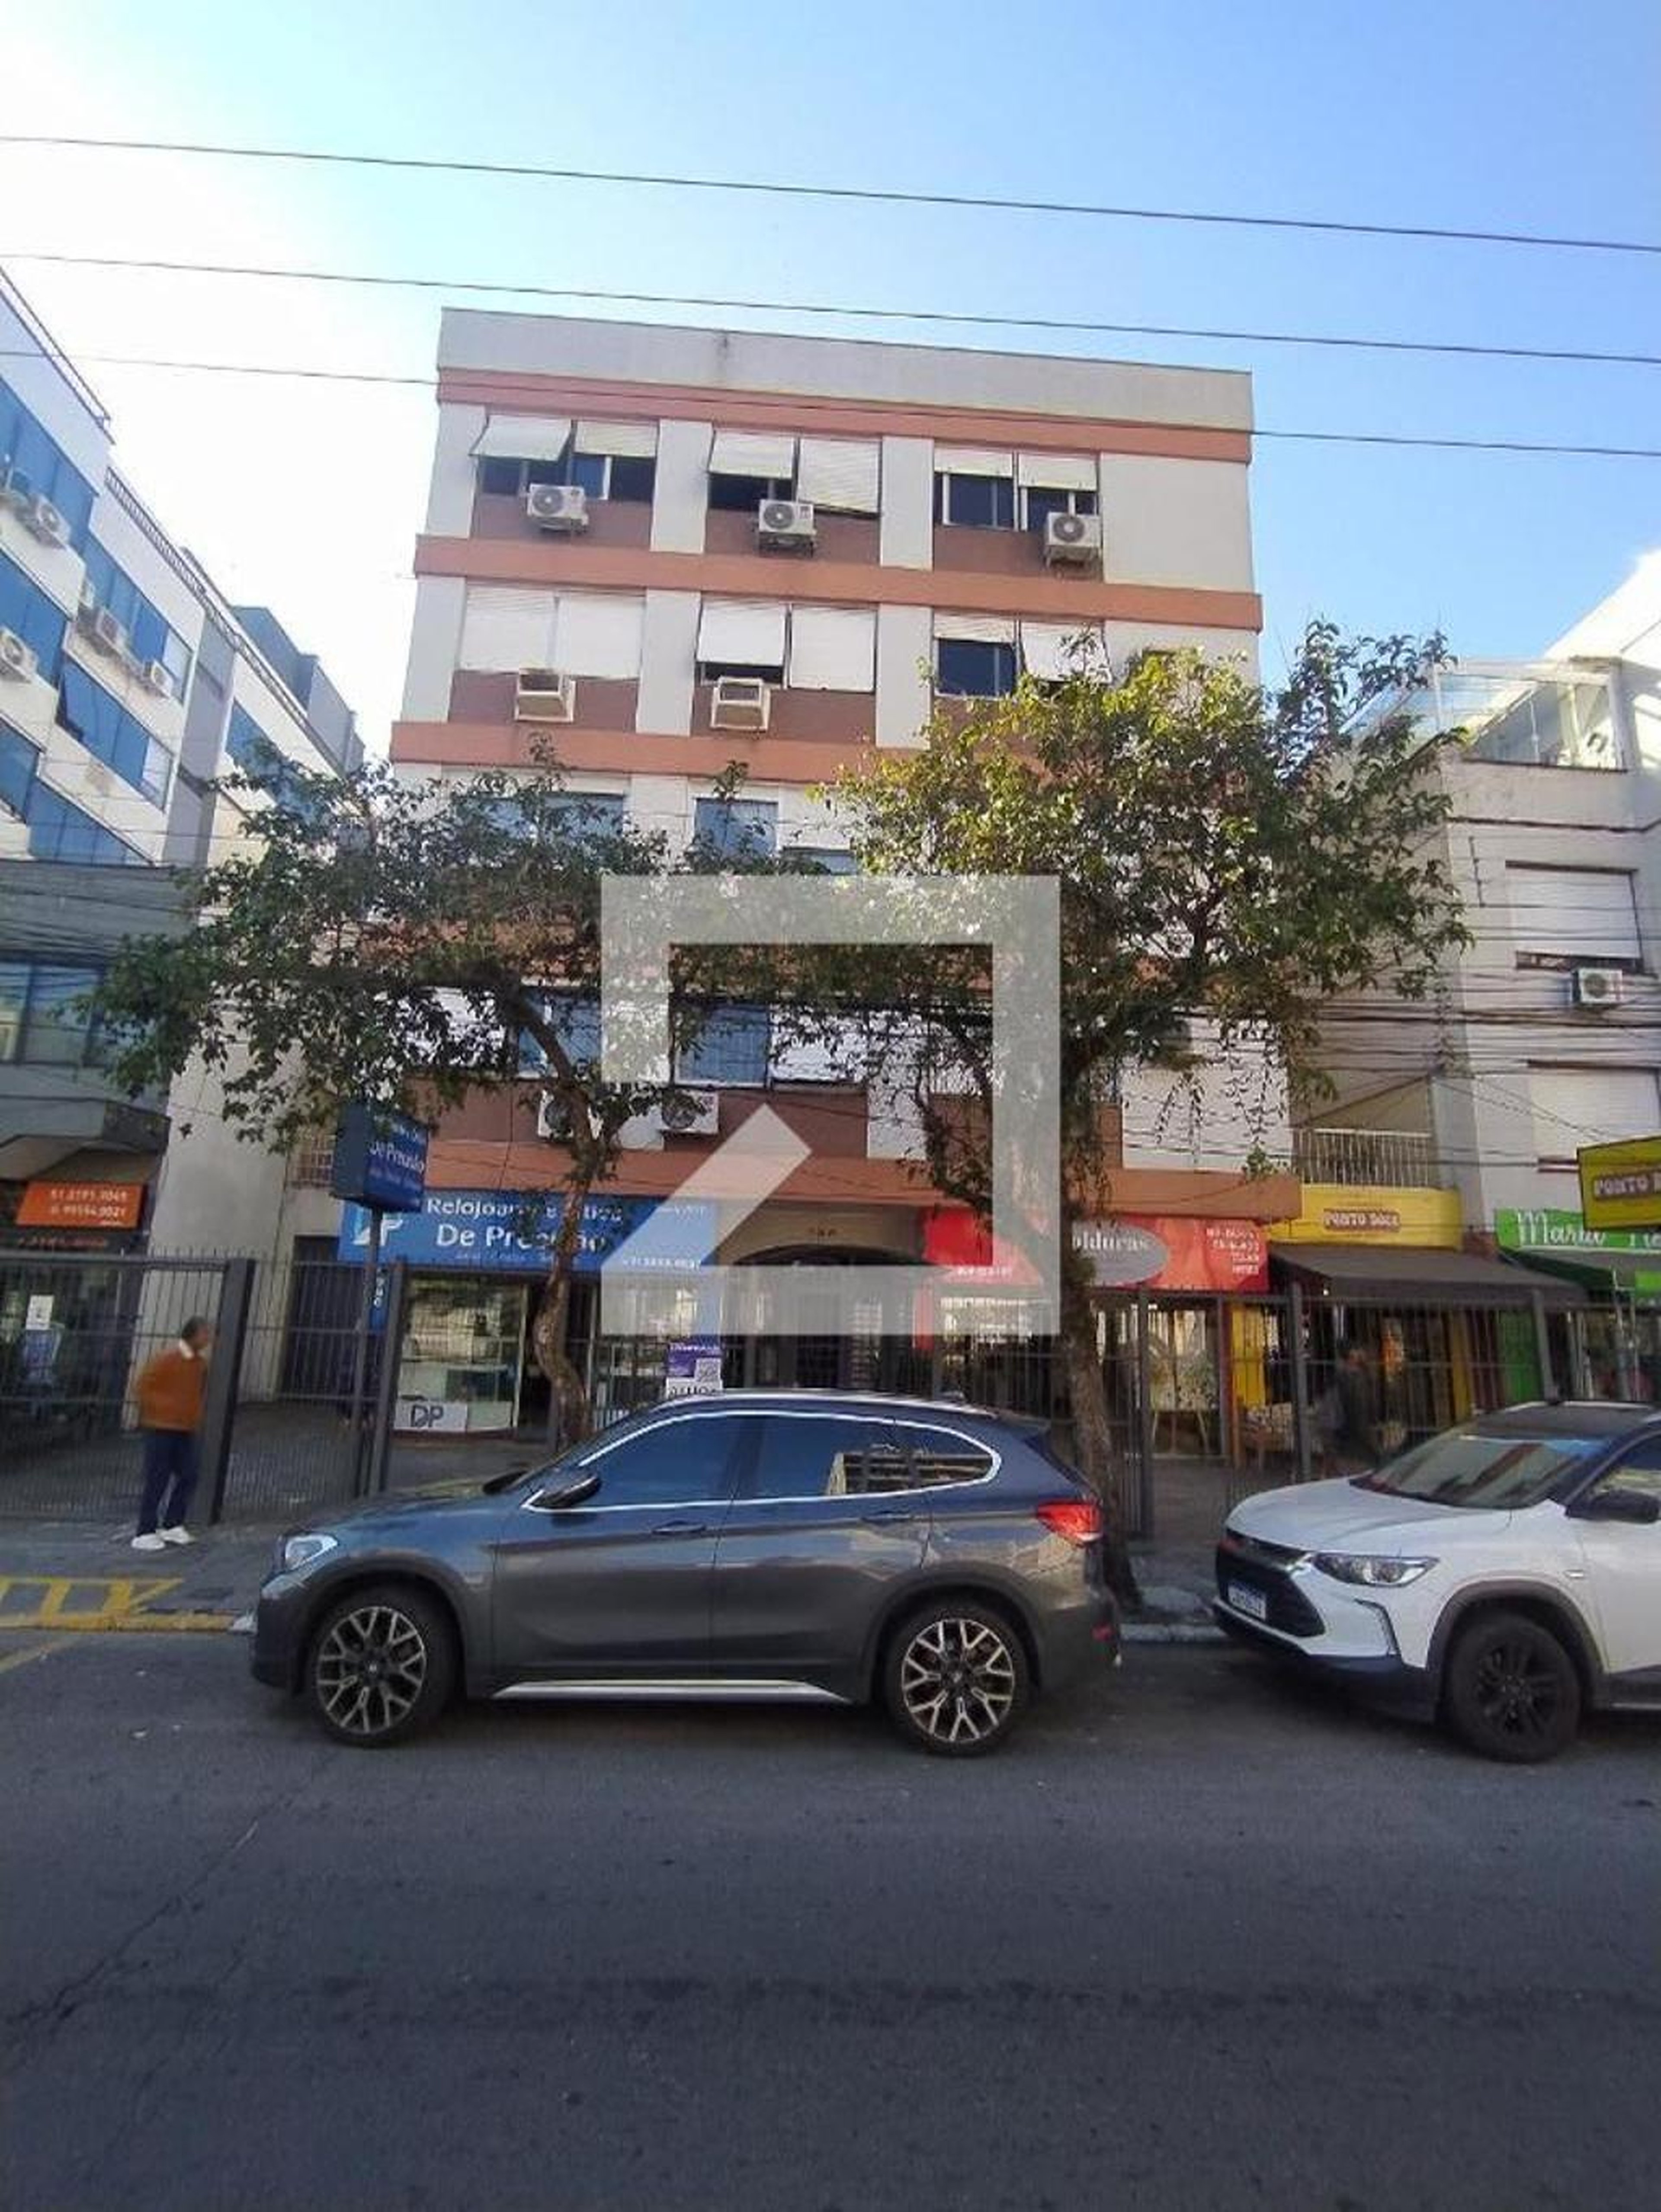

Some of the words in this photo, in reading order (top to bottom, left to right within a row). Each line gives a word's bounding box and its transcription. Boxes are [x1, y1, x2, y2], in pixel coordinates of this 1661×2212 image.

[436, 1223, 475, 1247] De
[1071, 1230, 1148, 1252] olduras
[411, 1405, 444, 1428] DP
